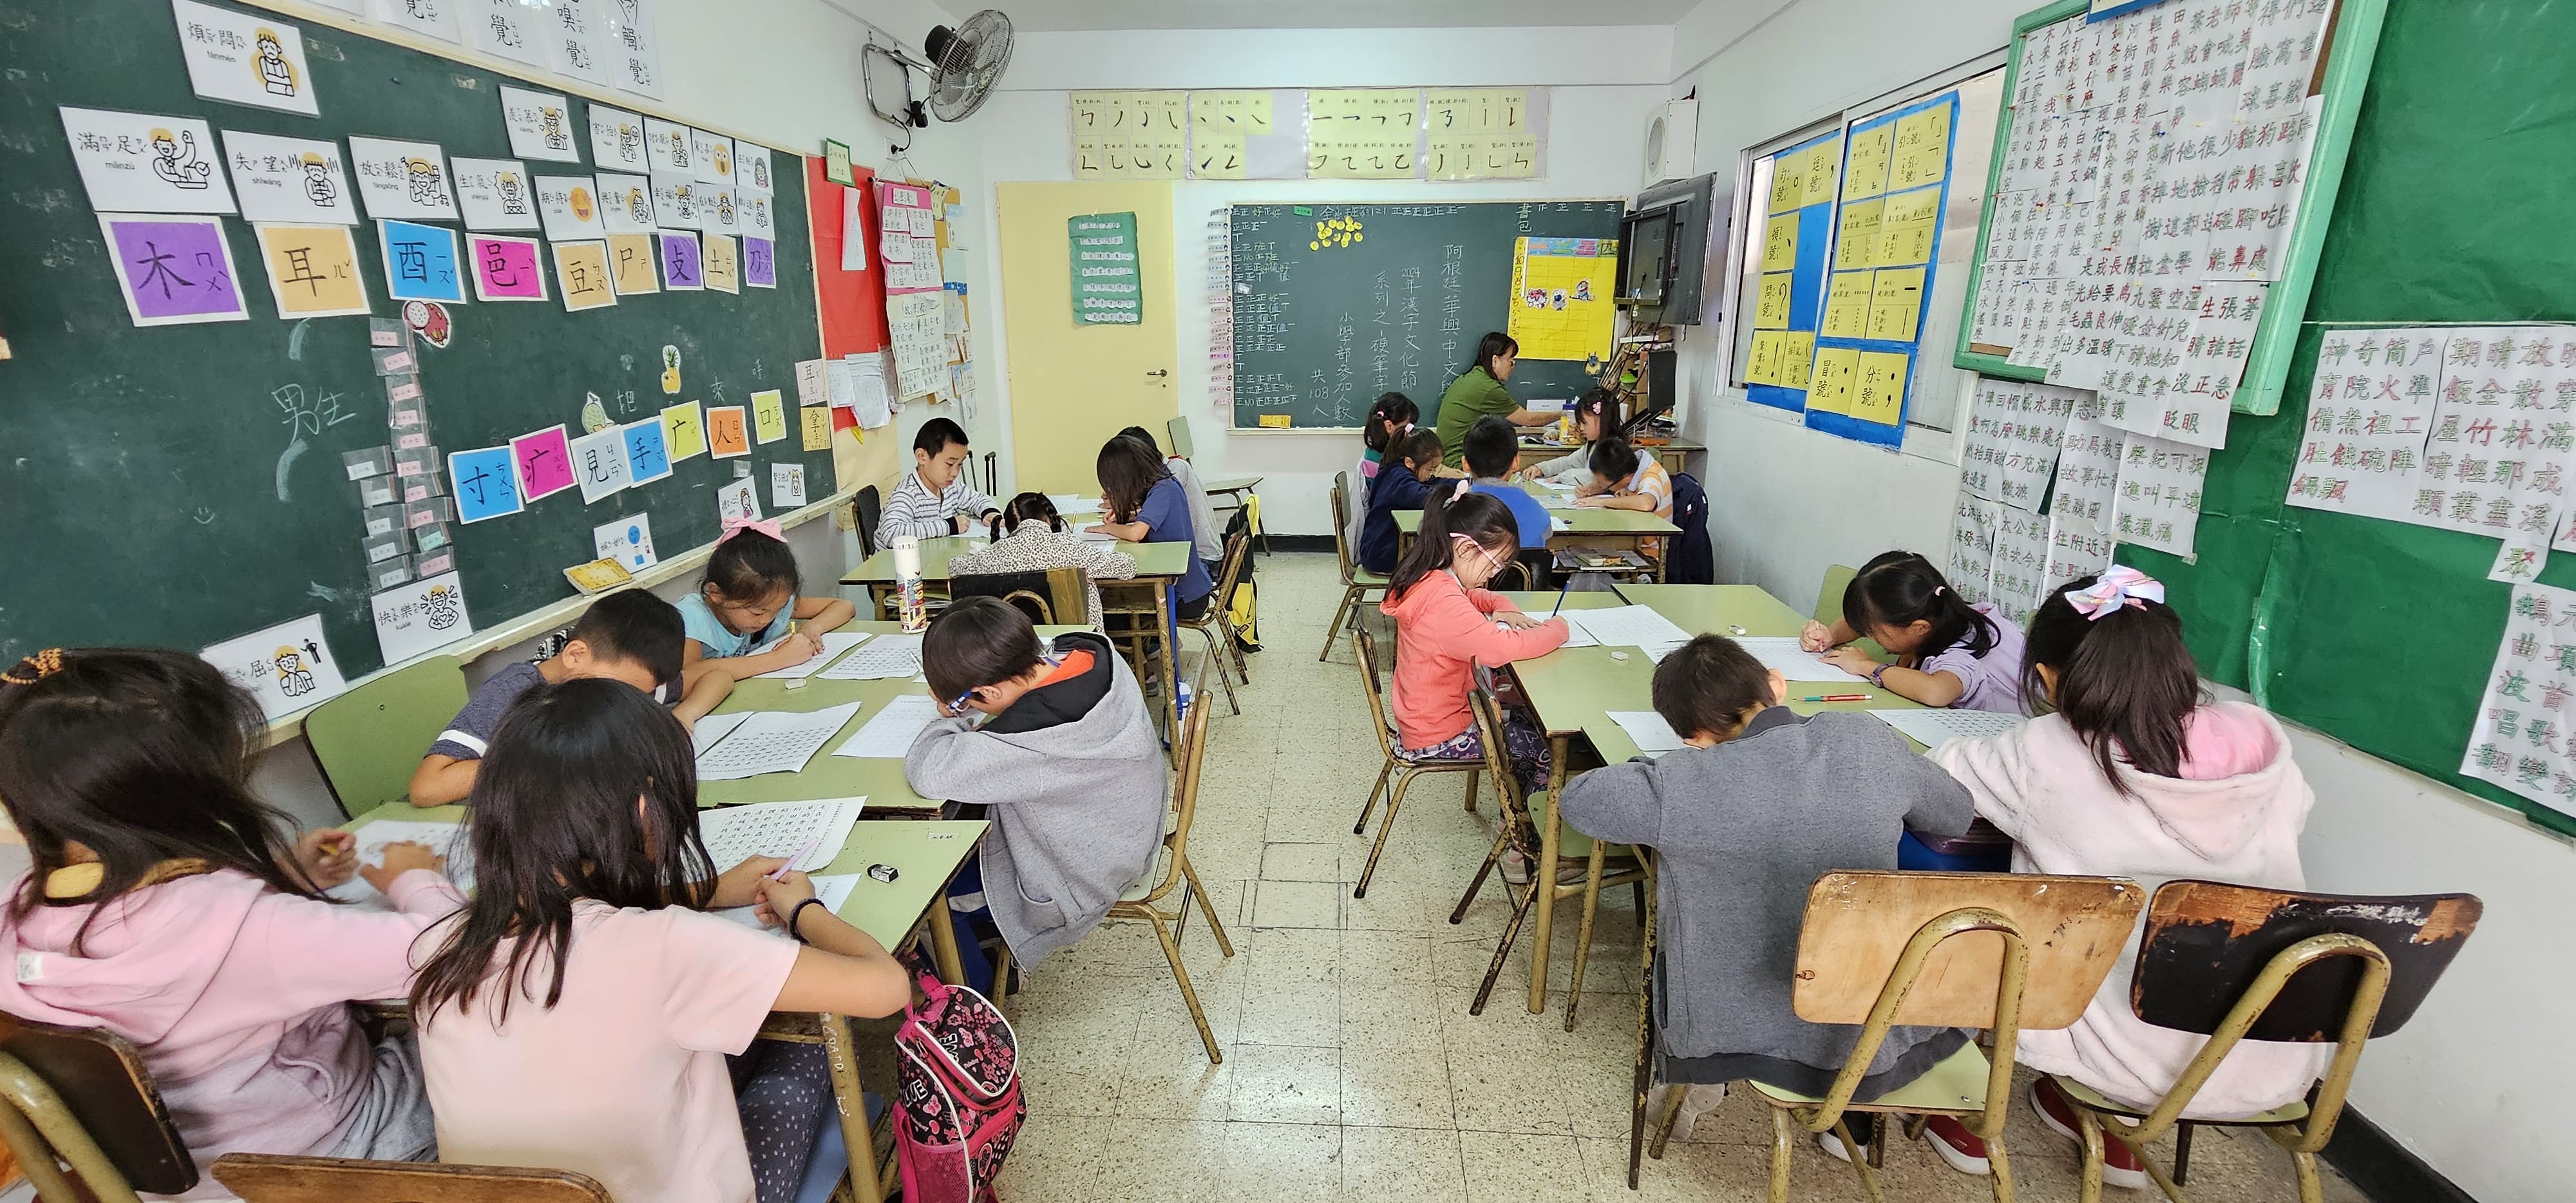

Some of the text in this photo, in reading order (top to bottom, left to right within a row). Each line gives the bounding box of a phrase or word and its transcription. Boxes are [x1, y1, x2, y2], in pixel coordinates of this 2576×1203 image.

[136, 240, 196, 301] 木
[283, 247, 327, 298] 耳
[392, 242, 428, 284] 酉
[485, 243, 518, 287] 邑
[570, 260, 594, 295] 豆
[2320, 336, 2434, 367] 神奇筒戶
[2318, 373, 2432, 405] 育院火準
[714, 421, 732, 446] 人
[585, 449, 609, 486] 見
[632, 437, 651, 471] 手
[462, 466, 490, 506] 寸
